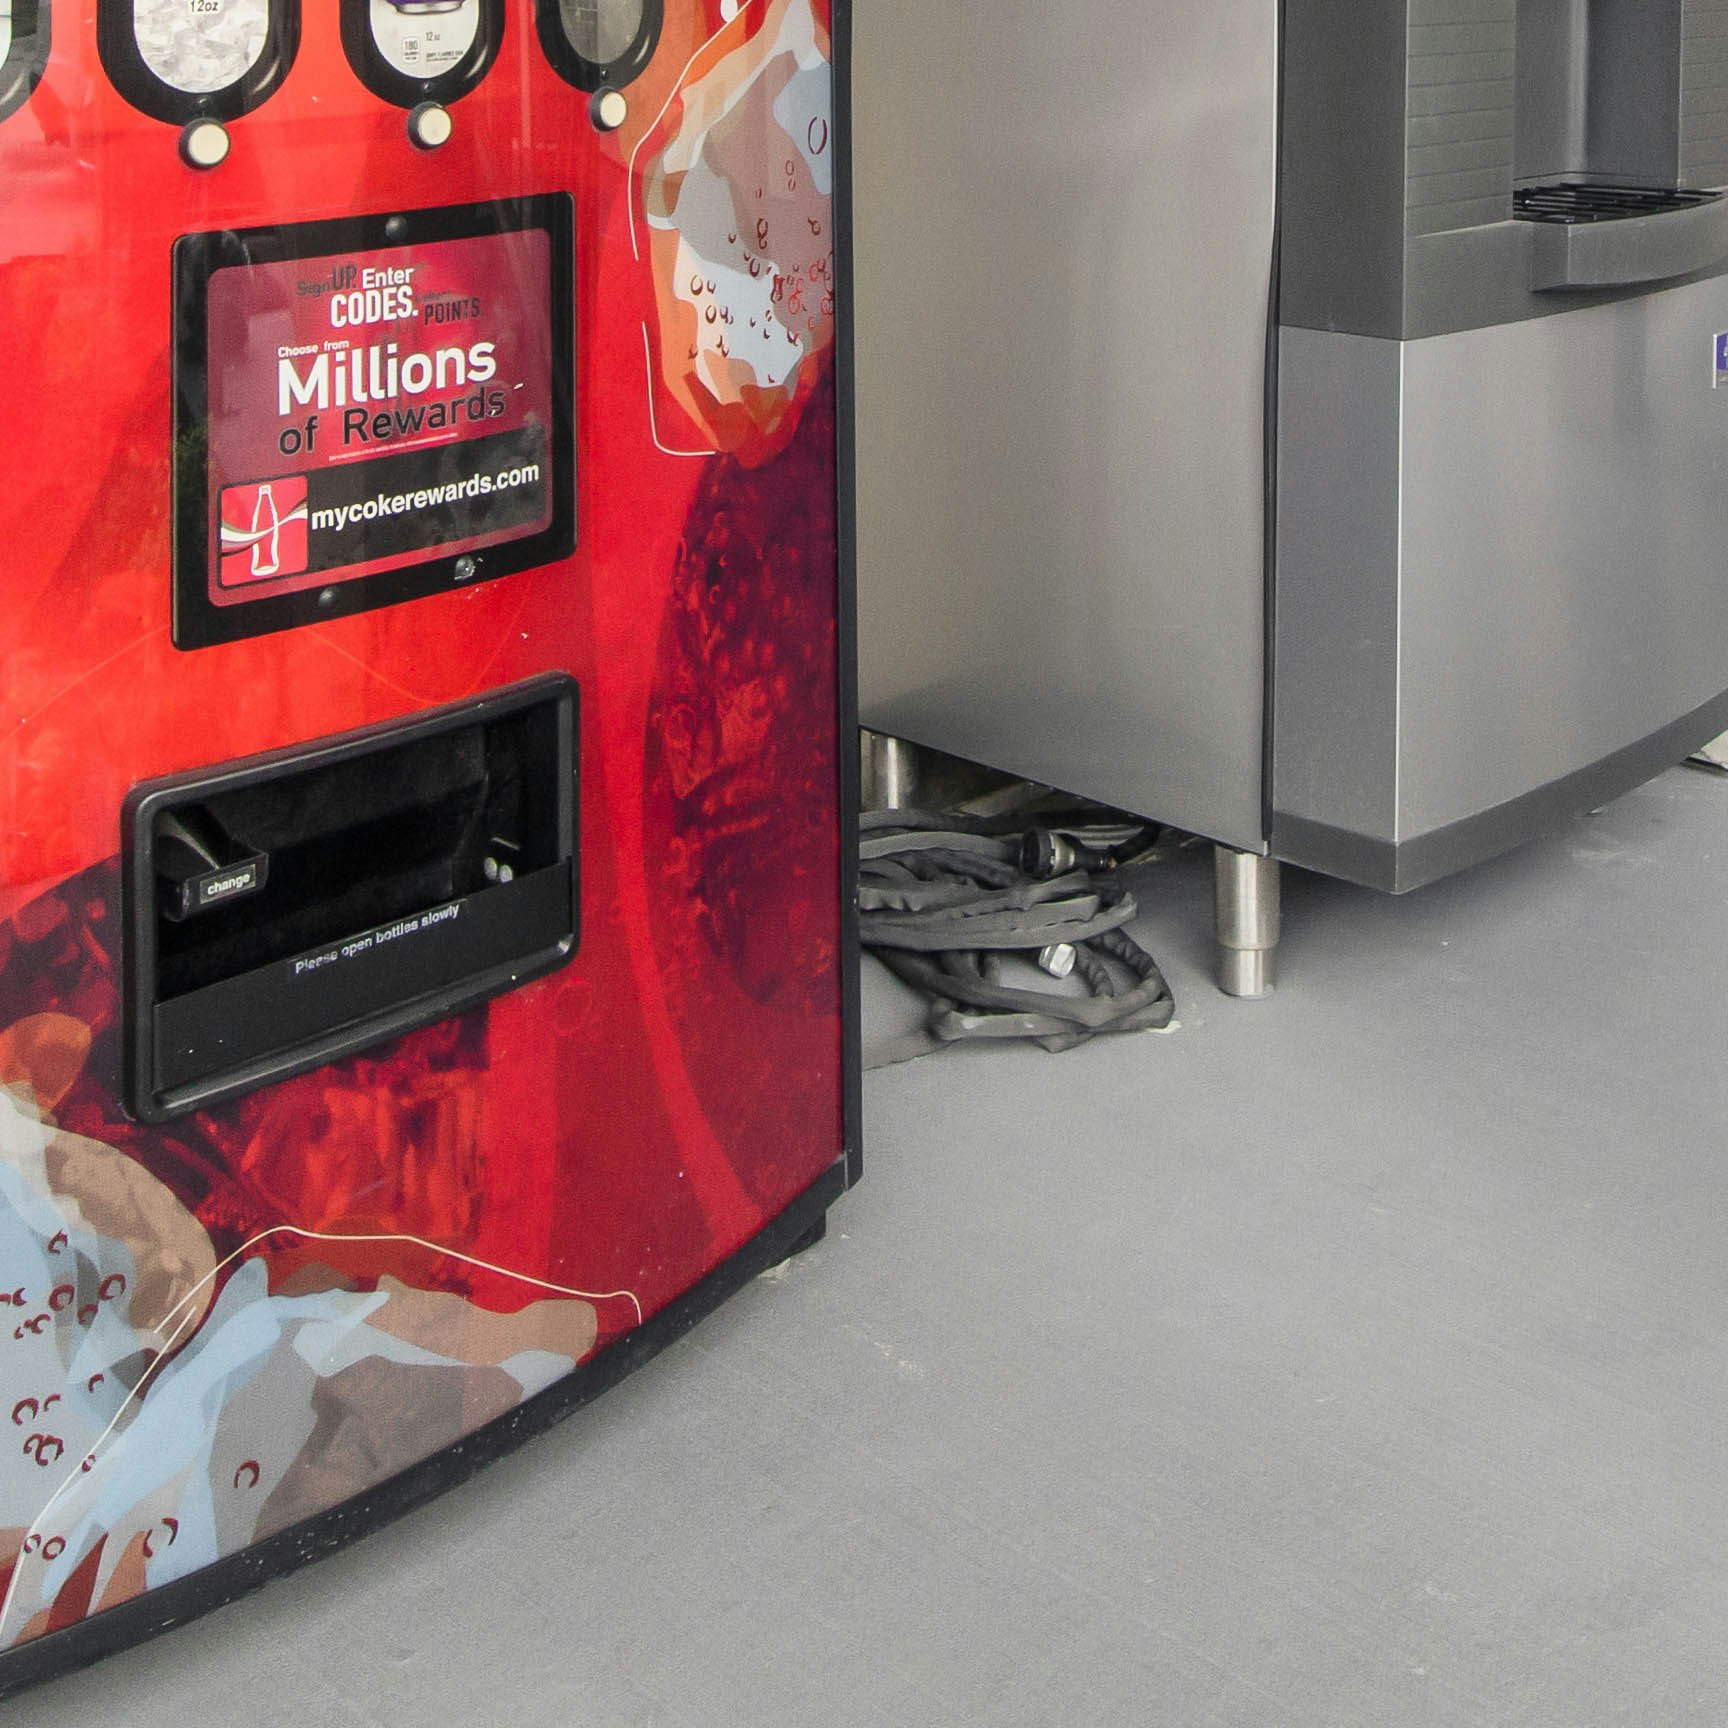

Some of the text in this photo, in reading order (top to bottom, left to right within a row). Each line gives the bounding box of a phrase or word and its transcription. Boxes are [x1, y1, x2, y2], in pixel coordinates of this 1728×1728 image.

[189, 0, 219, 12] 12oz
[362, 267, 414, 290] Enter
[330, 285, 419, 328] CODES.
[278, 340, 349, 358] Choose from
[279, 342, 497, 416] Millions
[279, 415, 318, 455] of
[343, 385, 506, 445] Rewards
[311, 464, 540, 532] mycokerewards.com
[207, 873, 251, 895] change
[295, 903, 460, 974] Please open bottles slowly
